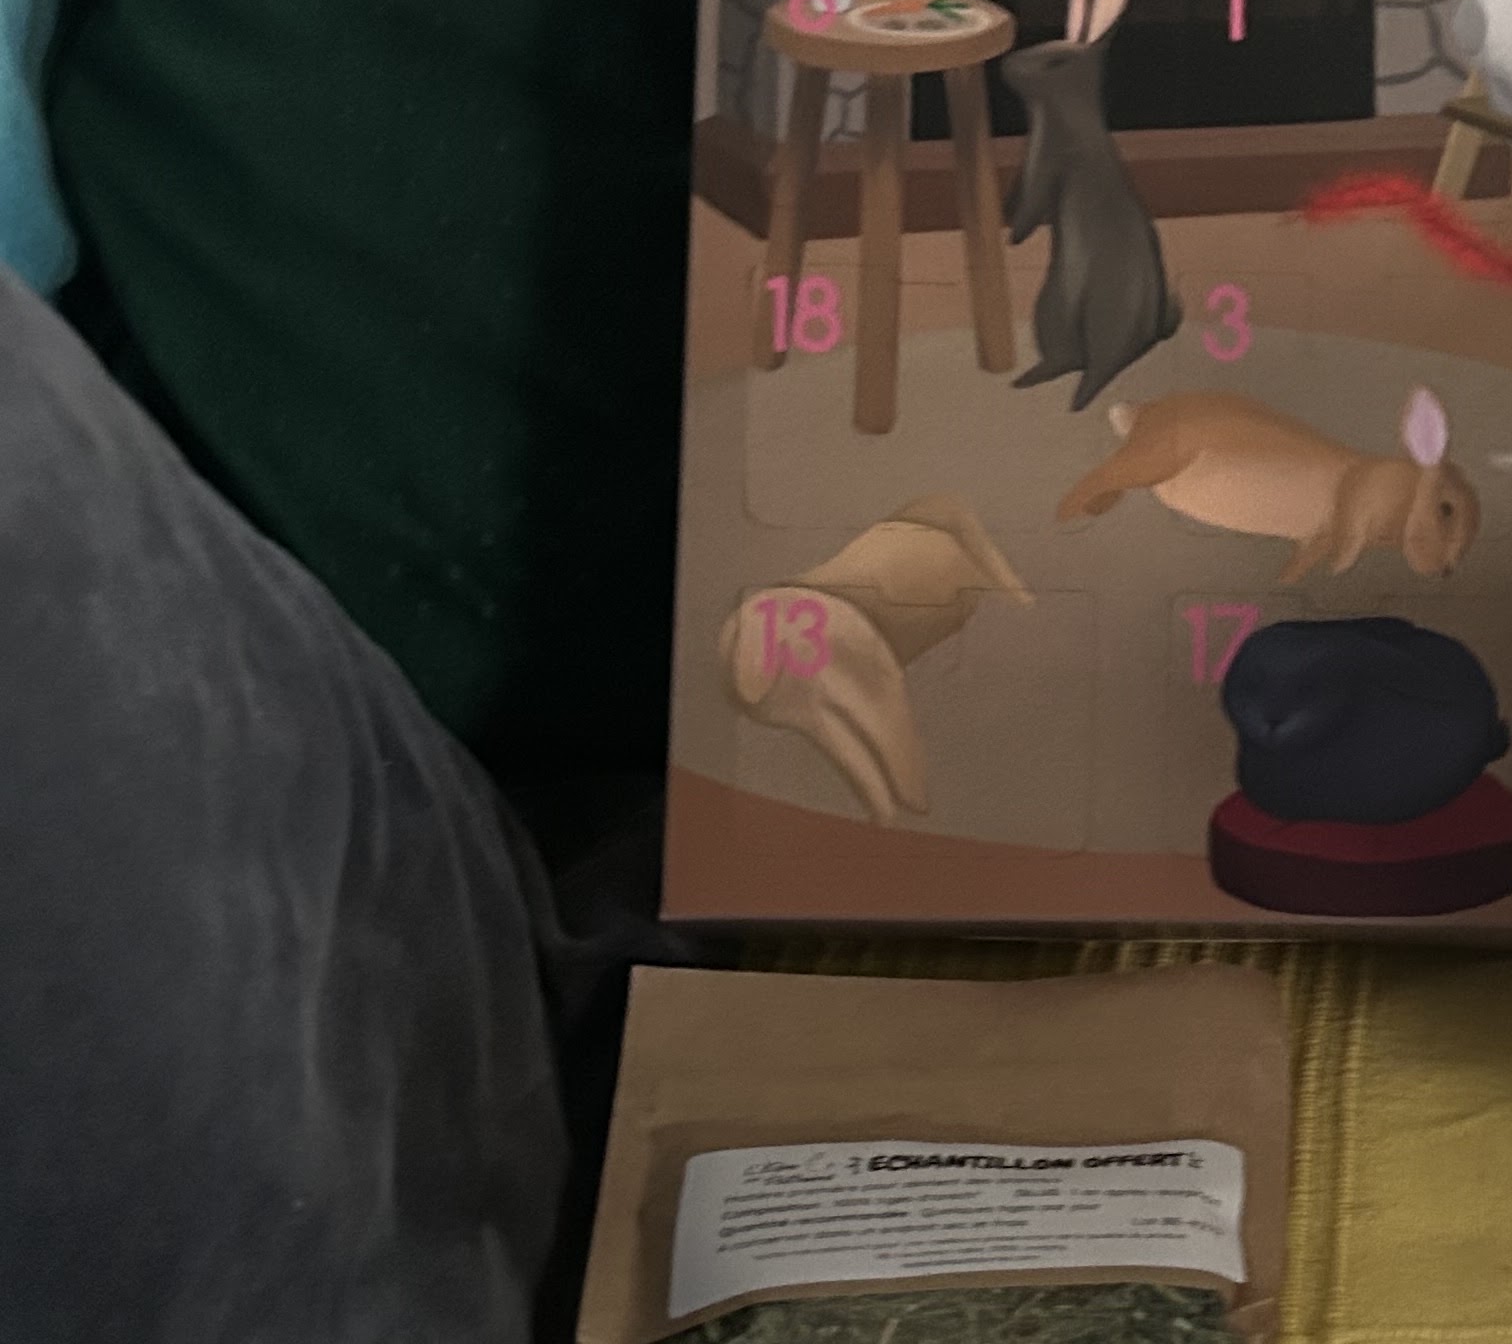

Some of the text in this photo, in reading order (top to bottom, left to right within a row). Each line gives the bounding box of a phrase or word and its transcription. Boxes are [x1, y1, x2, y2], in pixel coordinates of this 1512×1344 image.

[765, 277, 841, 354] 18
[1201, 285, 1251, 362] 3
[754, 600, 831, 678] 13
[1181, 603, 1261, 683] 17
